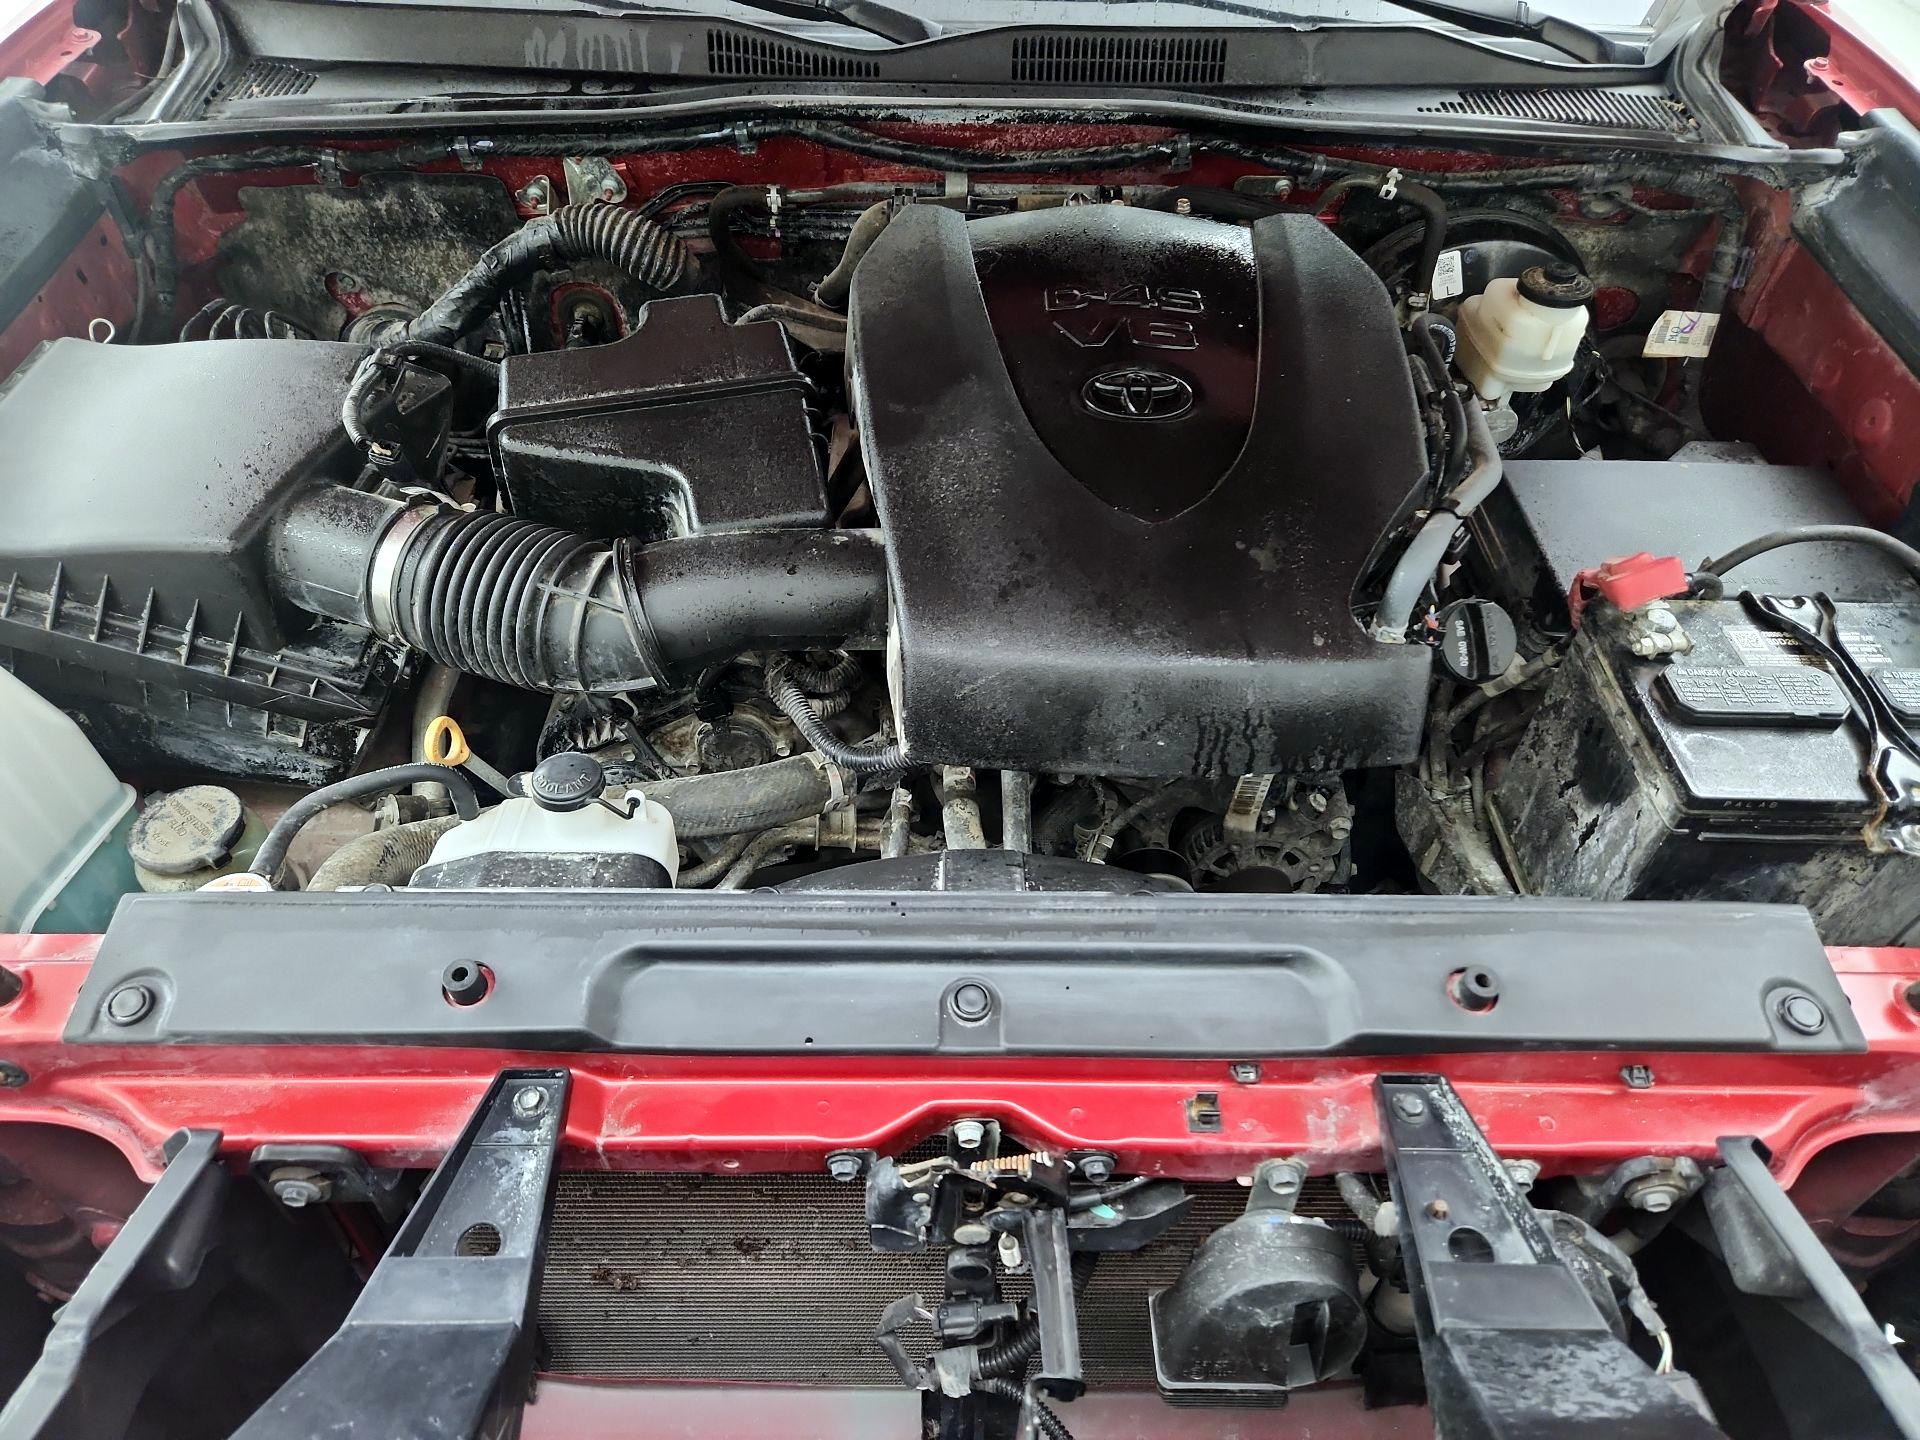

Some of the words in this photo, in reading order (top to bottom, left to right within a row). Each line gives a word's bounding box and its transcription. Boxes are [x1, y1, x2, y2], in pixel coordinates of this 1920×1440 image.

[1044, 283, 1204, 313] D-4S
[1052, 317, 1200, 350] V6
[1458, 641, 1469, 667] 0W-20
[1686, 668, 1719, 677] DANGER
[1726, 669, 1759, 677] POISON
[1891, 671, 1920, 679] DANGE
[535, 772, 592, 795] COOLANT
